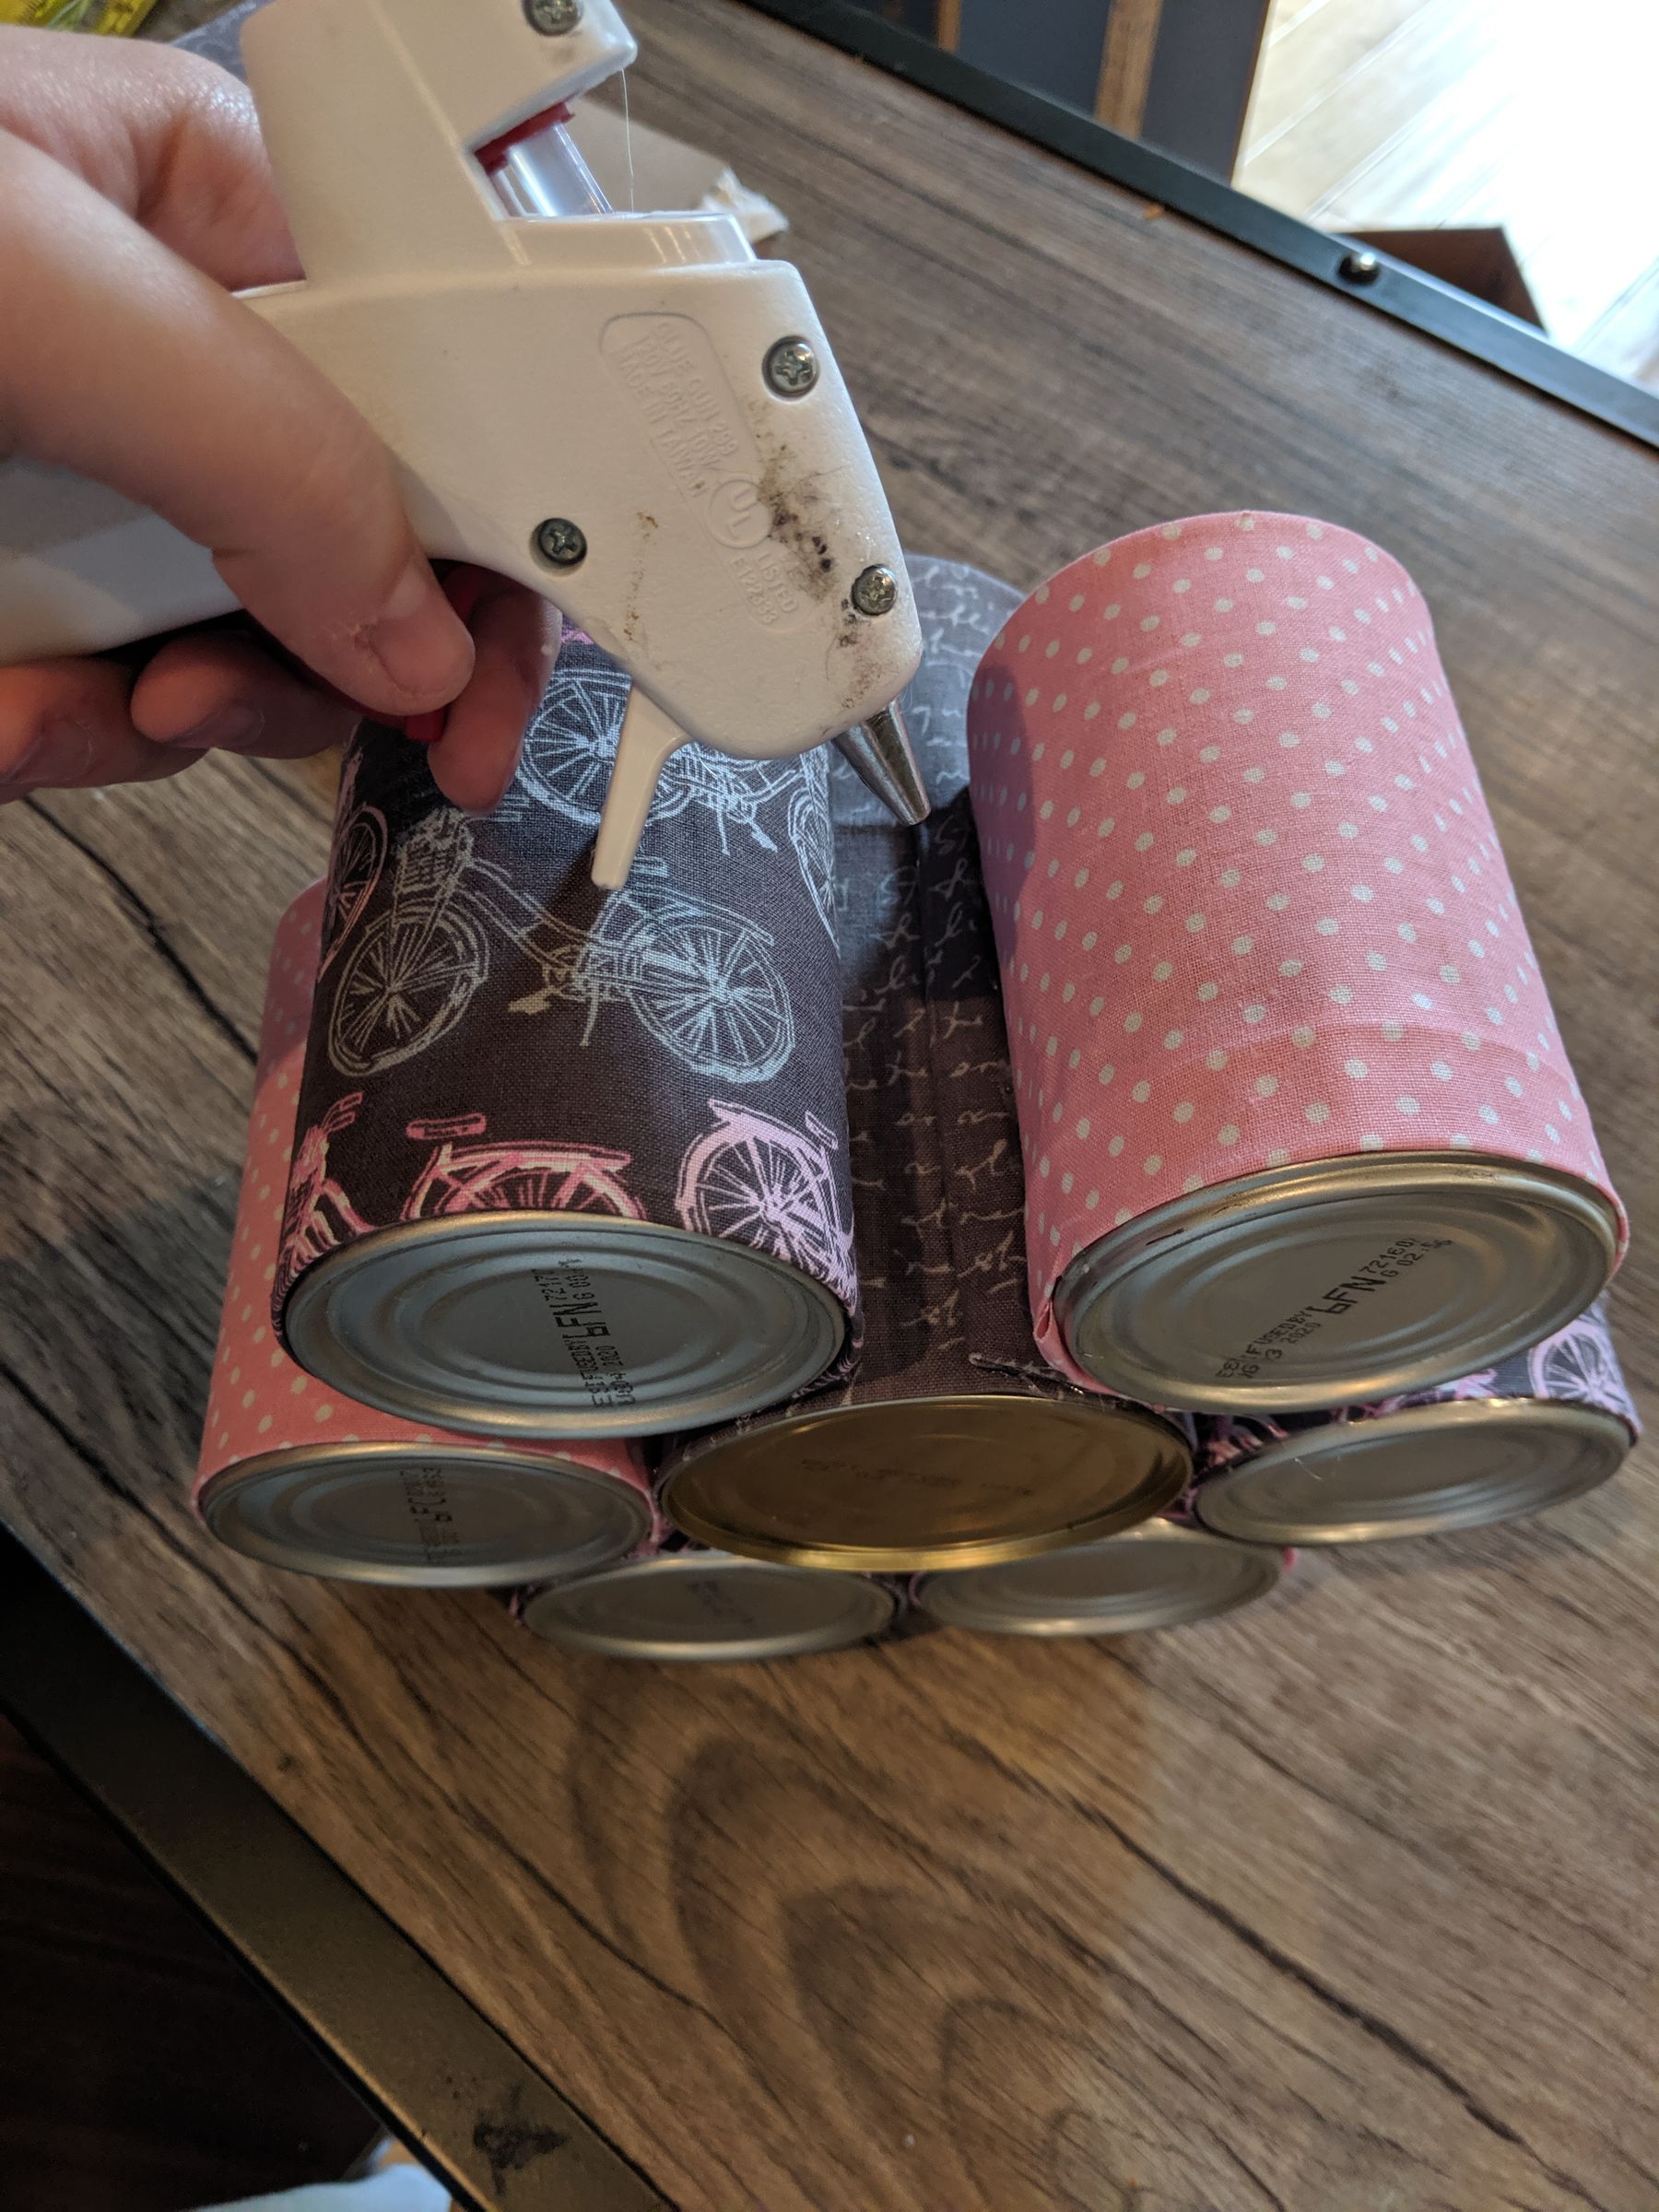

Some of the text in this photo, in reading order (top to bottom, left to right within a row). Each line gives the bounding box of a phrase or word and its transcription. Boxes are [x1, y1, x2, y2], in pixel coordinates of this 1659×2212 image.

[654, 320, 696, 372] GLUE
[685, 374, 722, 423] GUN
[611, 344, 710, 500] MADE IN TAIWAN
[756, 552, 800, 614] LISTED
[594, 1345, 624, 1367] 2020
[1280, 1321, 1323, 1345] 2020
